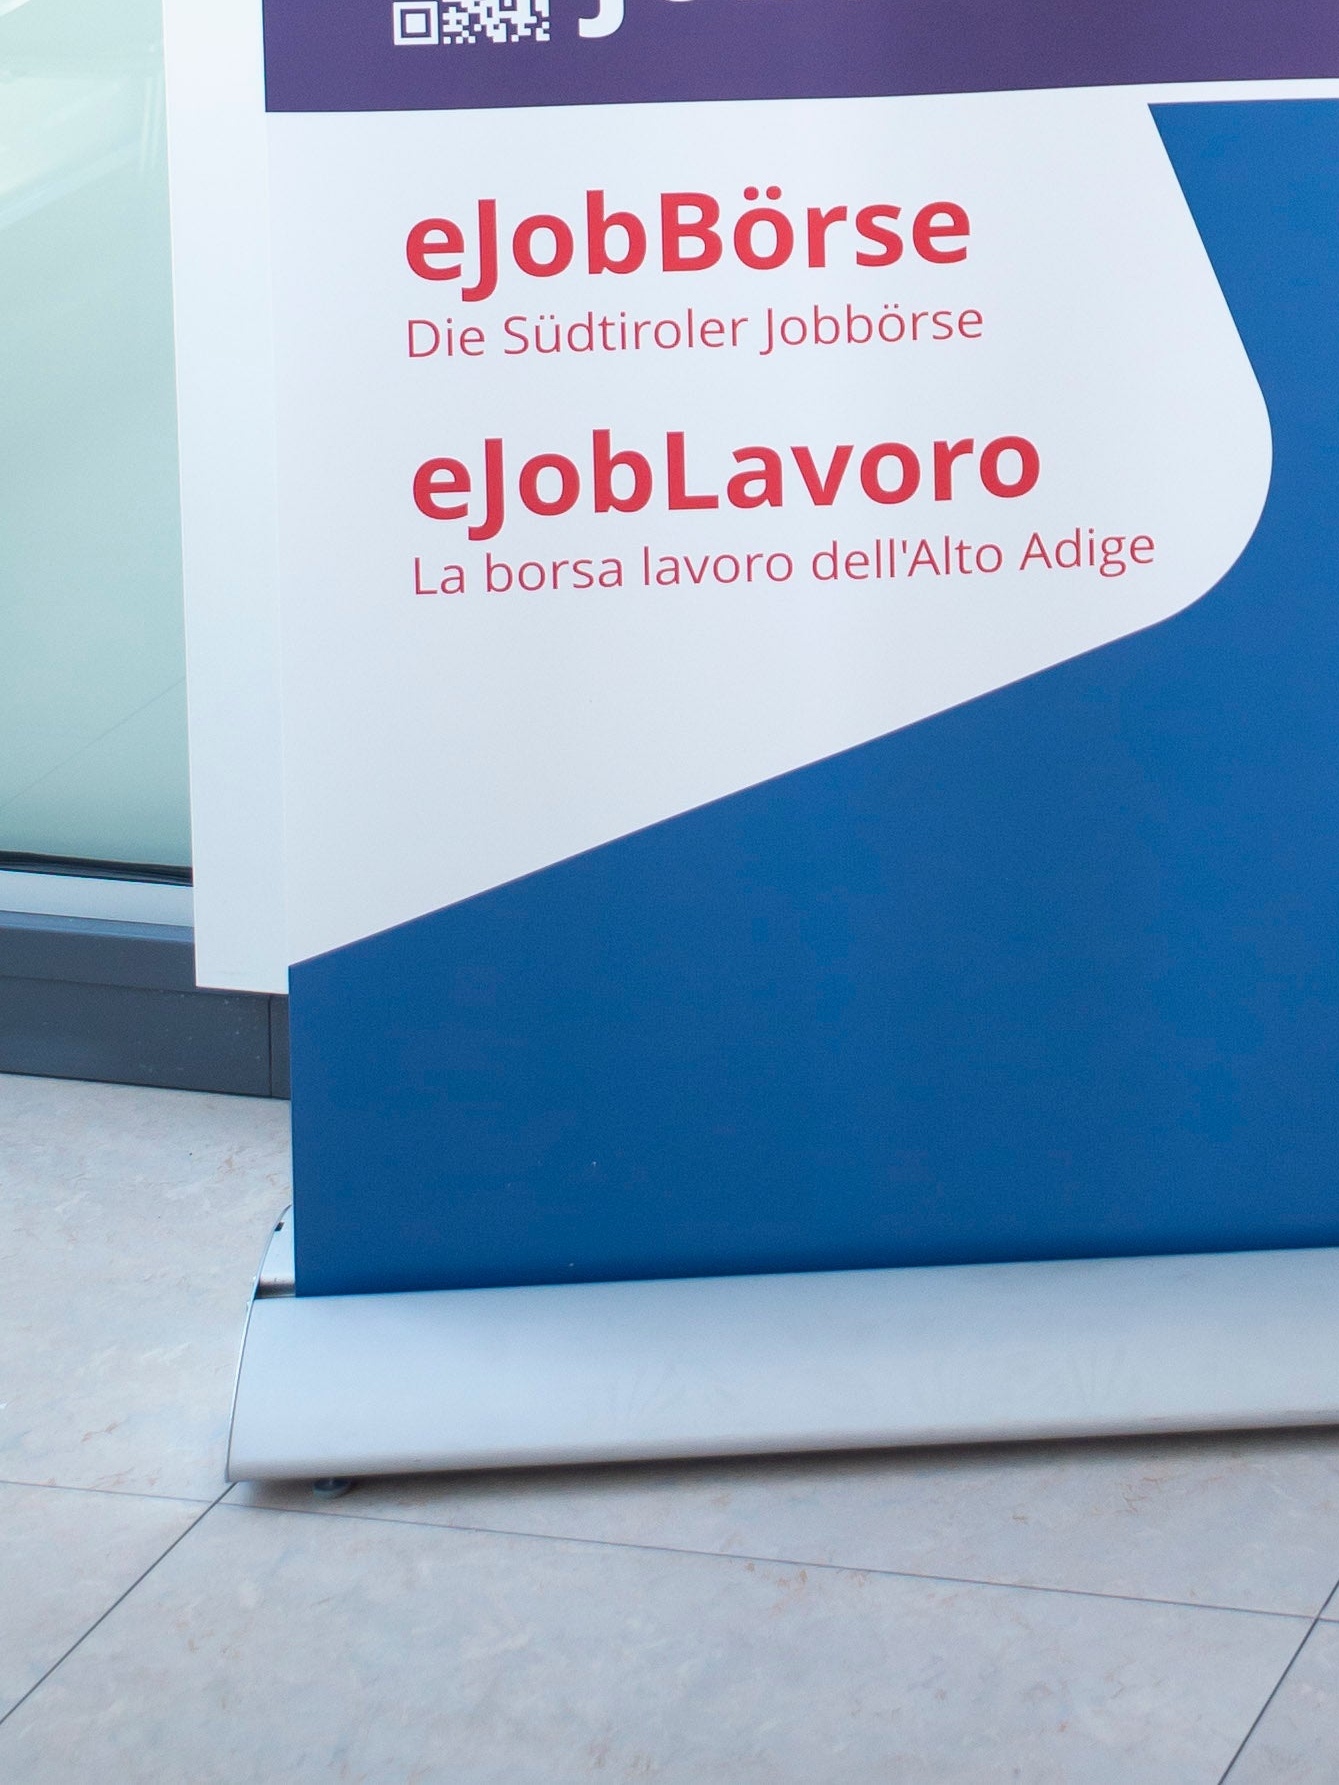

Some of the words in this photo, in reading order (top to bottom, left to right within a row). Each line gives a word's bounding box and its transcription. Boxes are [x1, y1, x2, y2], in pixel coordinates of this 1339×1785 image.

[404, 185, 972, 303] eJobBörse
[407, 317, 485, 358] Die
[502, 307, 749, 355] Südtiroler
[759, 303, 984, 356] Jobbörse
[412, 428, 1043, 540] eJobLavoro
[413, 556, 466, 597] La
[485, 551, 624, 594] borsa
[642, 544, 794, 587] lavoro
[811, 535, 1004, 582] dell'Alto
[1018, 527, 1156, 580] Adige
